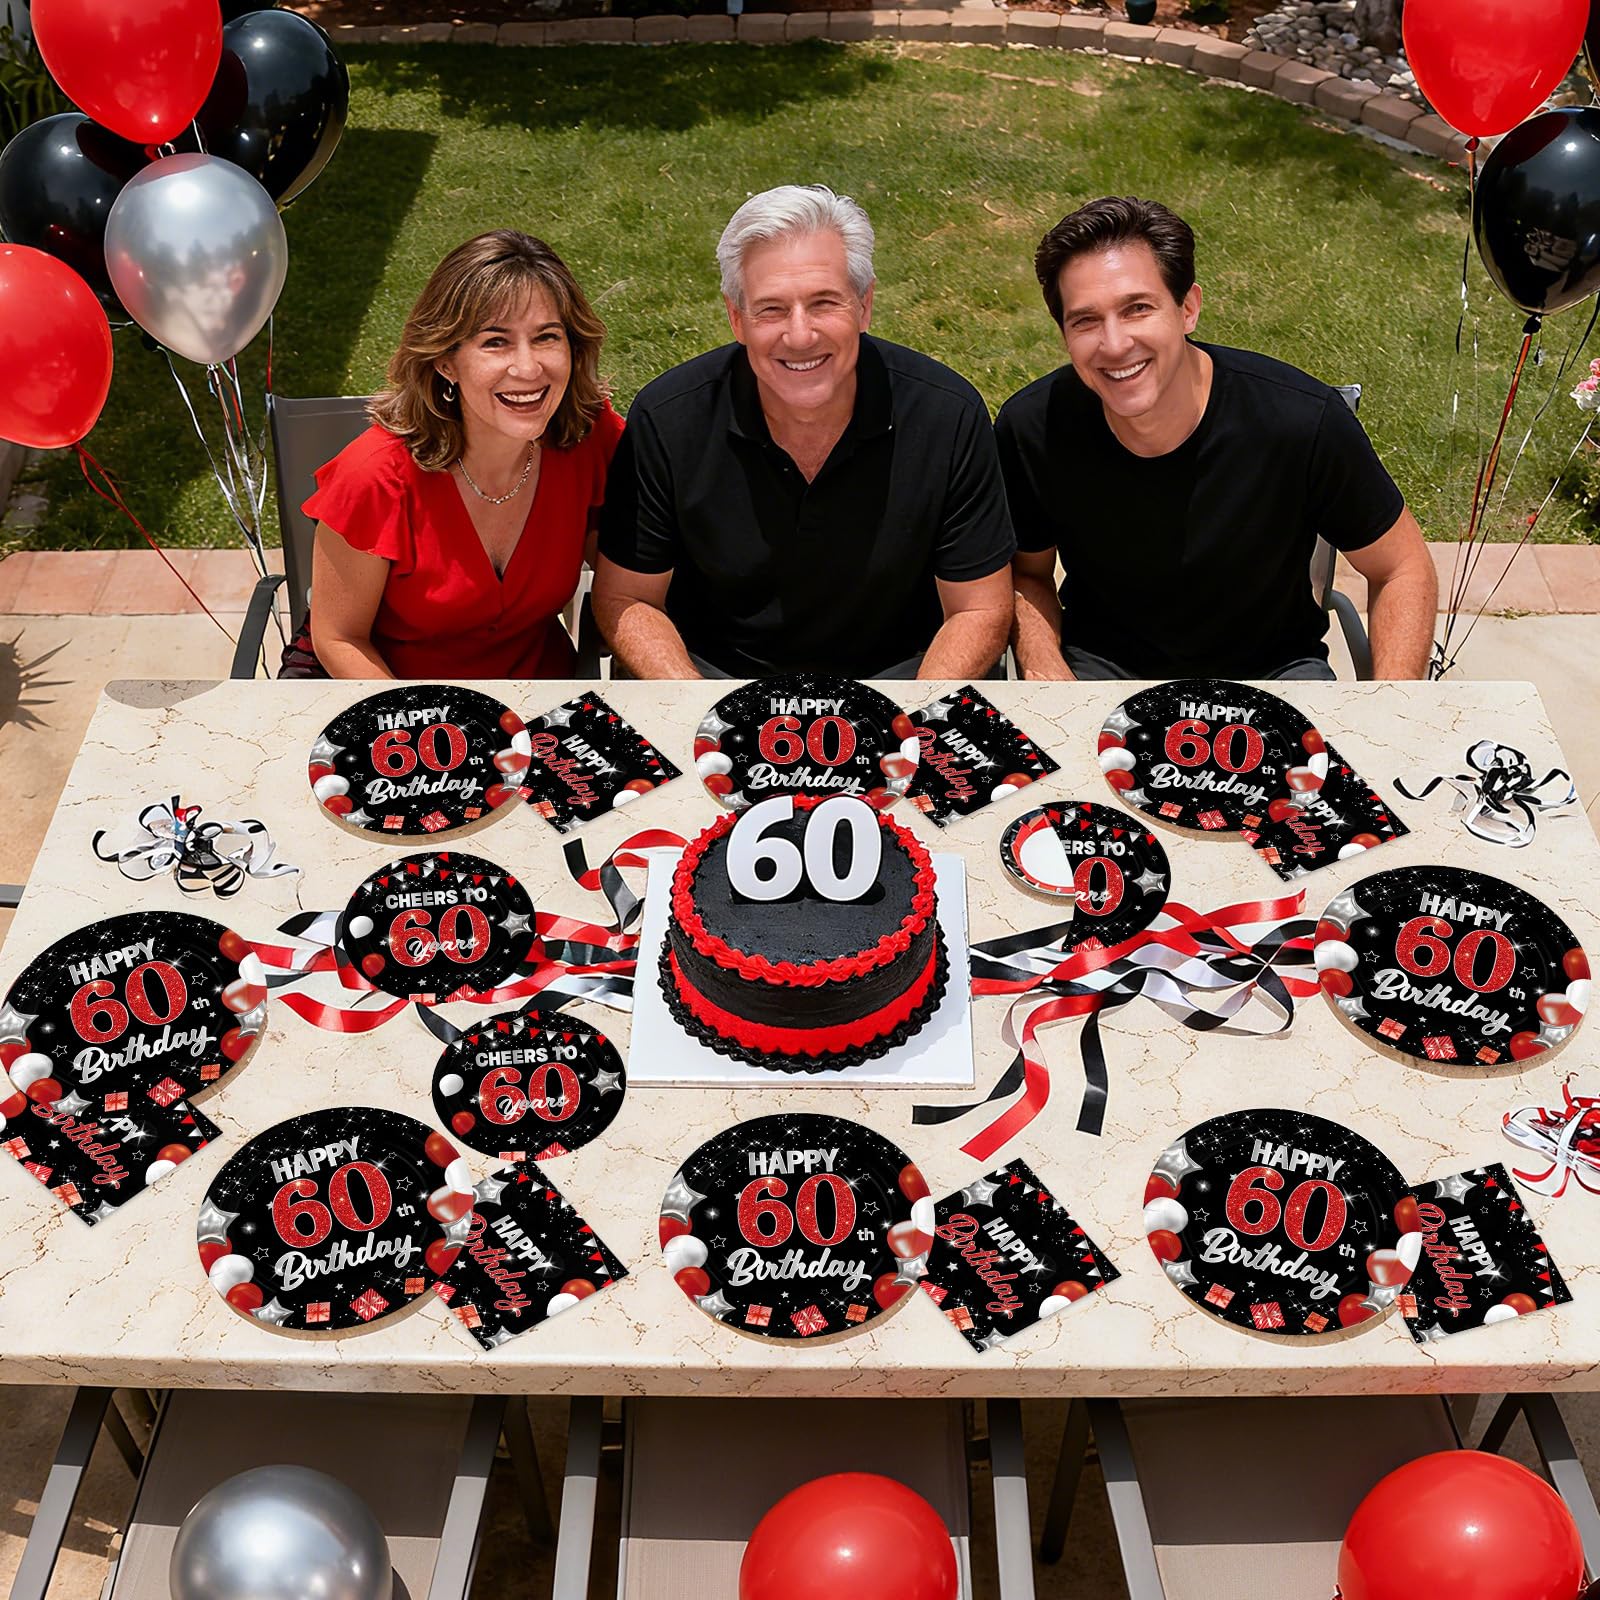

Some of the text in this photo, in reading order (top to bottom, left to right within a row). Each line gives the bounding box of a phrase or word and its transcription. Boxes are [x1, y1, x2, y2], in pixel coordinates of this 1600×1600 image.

[377, 705, 451, 730] HAPPY
[770, 697, 845, 716] HAPPY
[1179, 700, 1256, 725] HAPPY
[561, 733, 613, 776] HAPPY
[939, 728, 994, 770] HAPPY
[366, 772, 483, 805] Birthday
[747, 763, 865, 797] Birthday
[1149, 762, 1269, 807] Birthday
[726, 795, 882, 901] 60
[1060, 839, 1126, 857] ERS TO
[385, 887, 488, 910] CHEERS TO
[1073, 856, 1125, 917] 0
[1075, 890, 1113, 902] ars
[1419, 891, 1514, 932] HAPPY
[388, 904, 491, 967] 60
[408, 938, 480, 963] Years
[68, 938, 156, 986] HAPPY
[1370, 968, 1513, 1036] Birthday
[72, 1025, 217, 1084] Birthday
[475, 1045, 578, 1068] CHEERS TO
[479, 1062, 581, 1126] 60
[498, 1096, 572, 1121] Years
[271, 1136, 361, 1184] HAPPY
[748, 1147, 839, 1176] HAPPY
[1250, 1138, 1345, 1181] HAPPY
[275, 1232, 422, 1293] Birthday
[490, 1214, 553, 1273] HAPPY
[982, 1216, 1045, 1275] HAPPY
[1200, 1227, 1341, 1300] Birthday
[1448, 1215, 1500, 1277] HAPPY
[727, 1247, 872, 1292] Birthday
[935, 1213, 1024, 1320] Birthday
